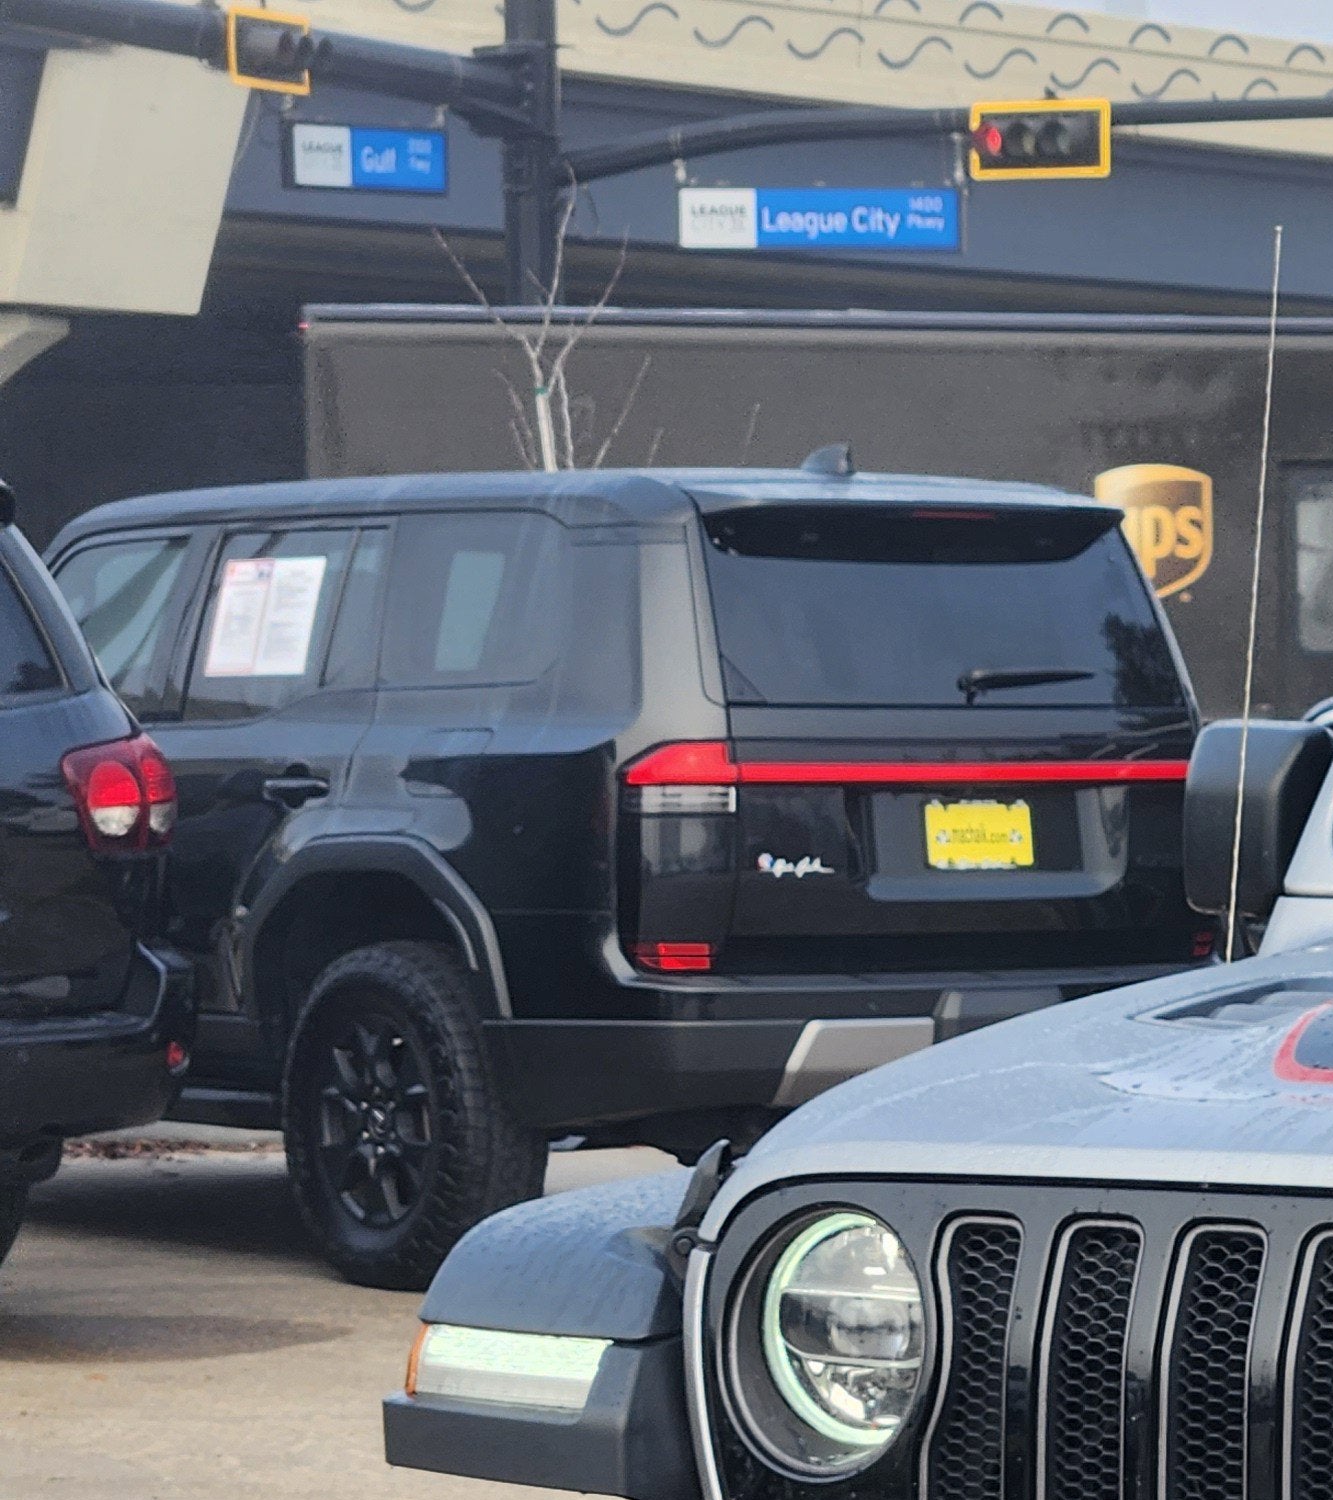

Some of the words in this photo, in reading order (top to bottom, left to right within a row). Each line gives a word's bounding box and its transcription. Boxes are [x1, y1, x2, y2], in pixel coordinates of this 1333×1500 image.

[691, 204, 748, 217] LEAGUE
[762, 206, 848, 239] League
[851, 206, 901, 238] City
